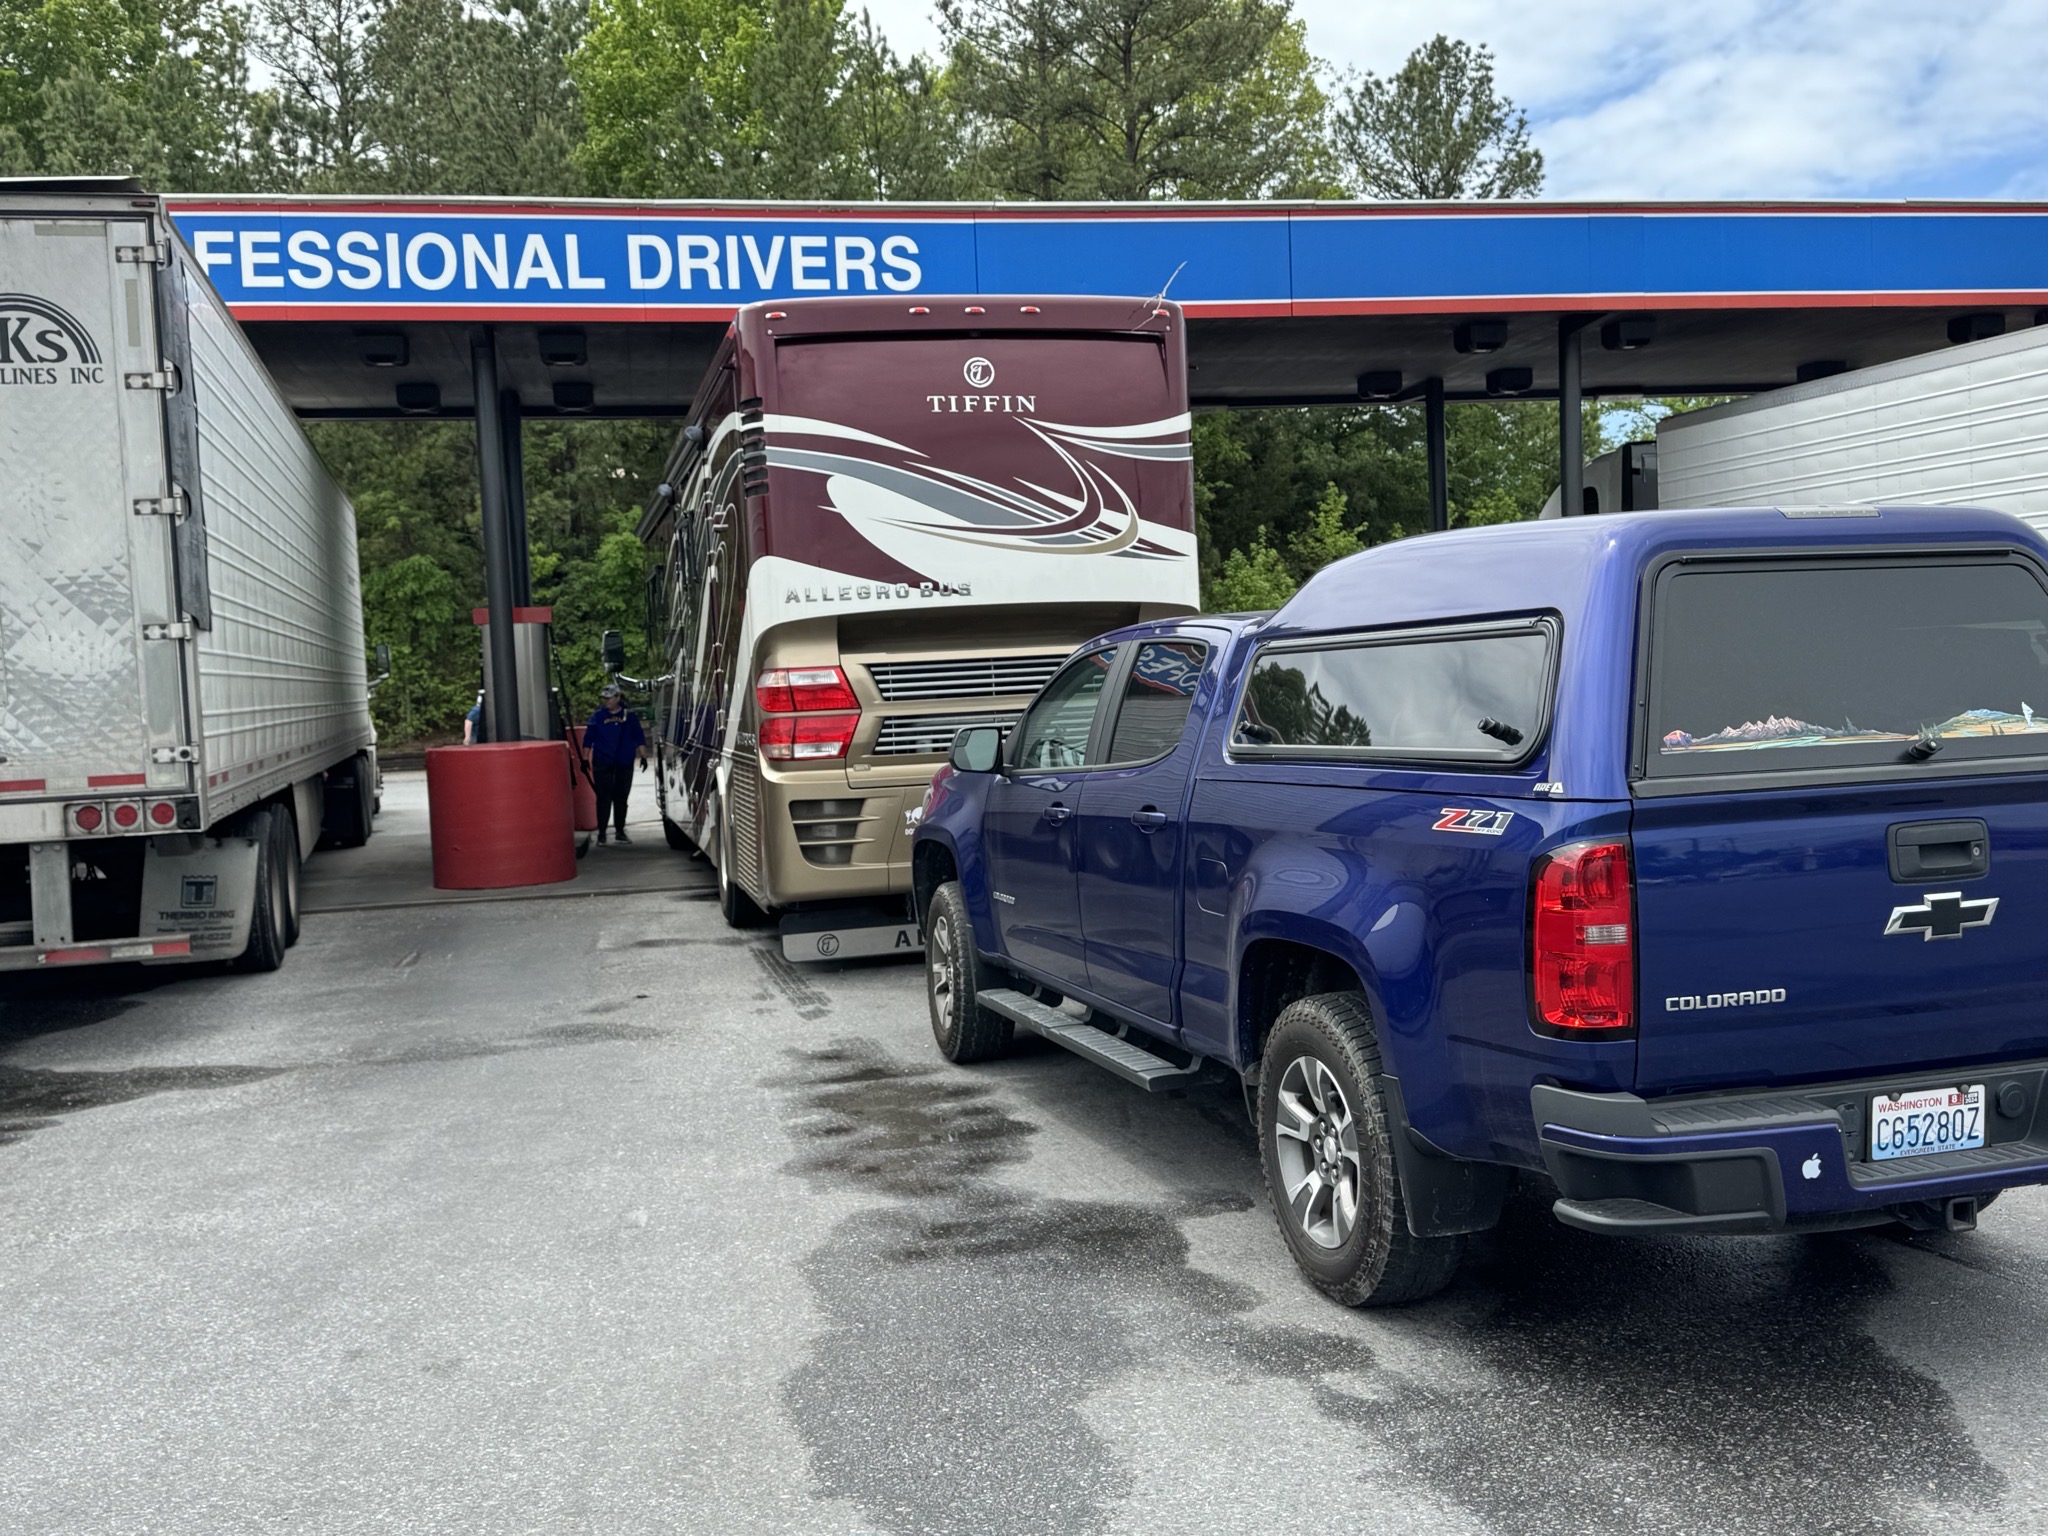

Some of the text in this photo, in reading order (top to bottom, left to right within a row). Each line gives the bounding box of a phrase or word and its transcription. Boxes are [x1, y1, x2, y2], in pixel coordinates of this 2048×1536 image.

[194, 230, 922, 292] FESSIONAL DRIVERS
[0, 367, 104, 385] LINES INC
[926, 395, 1037, 412] TIFFIN
[785, 581, 973, 604] ALLEGRO BUS
[1432, 808, 1514, 834] Z71
[158, 909, 235, 921] THERMO KING
[1665, 988, 1786, 1012] COLORADO
[1878, 1097, 1943, 1113] WASHINGTON
[1877, 1106, 1979, 1151] C65280Z
[1900, 1144, 1956, 1156] EVERGREEN STATE
